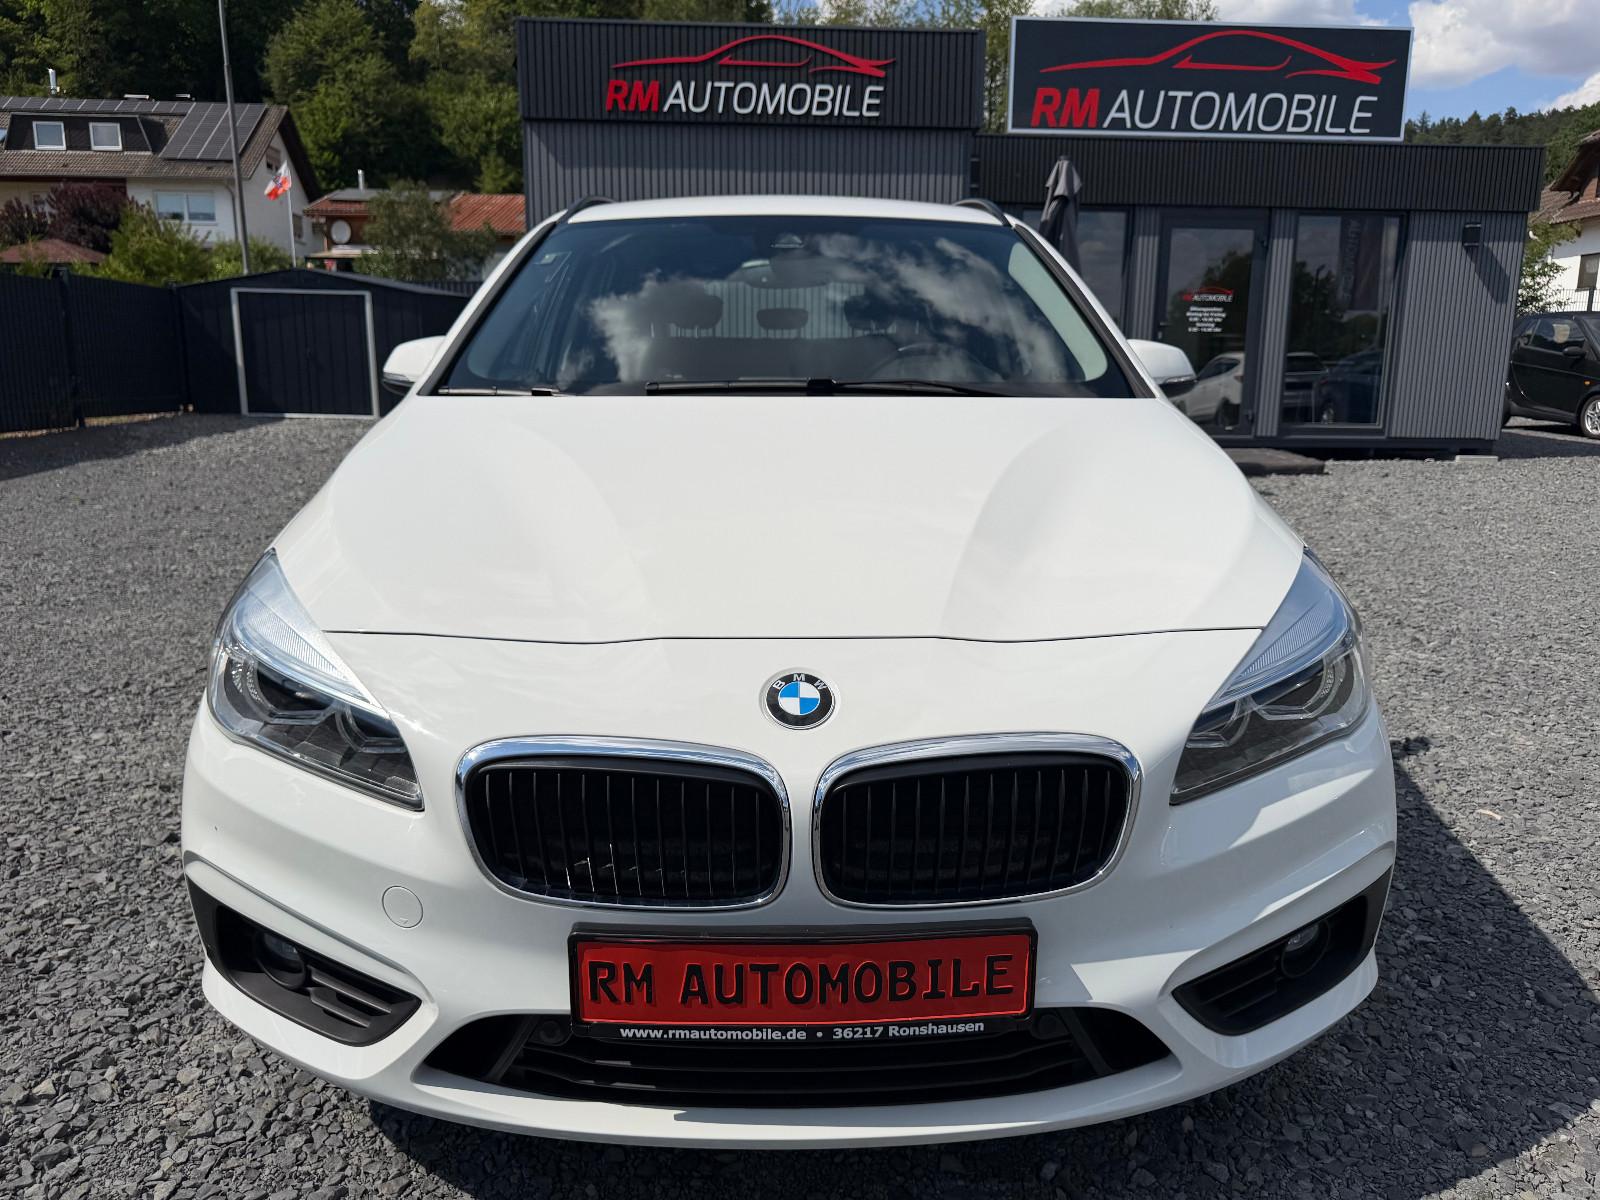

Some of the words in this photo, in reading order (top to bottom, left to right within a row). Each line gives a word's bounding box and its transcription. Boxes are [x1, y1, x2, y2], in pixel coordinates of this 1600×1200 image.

[606, 80, 660, 112] RM
[663, 81, 884, 117] AUTOMOBILE
[1030, 87, 1100, 129] RM
[1102, 88, 1379, 135] AUTOMOBILE
[772, 673, 828, 690] BMW
[588, 960, 653, 1004] RM
[680, 953, 1015, 1006] AUTOMOBILE
[619, 1026, 807, 1041] www.rmautomobile.de
[832, 1026, 884, 1040] 36217
[888, 1020, 985, 1038] Ronshausen
